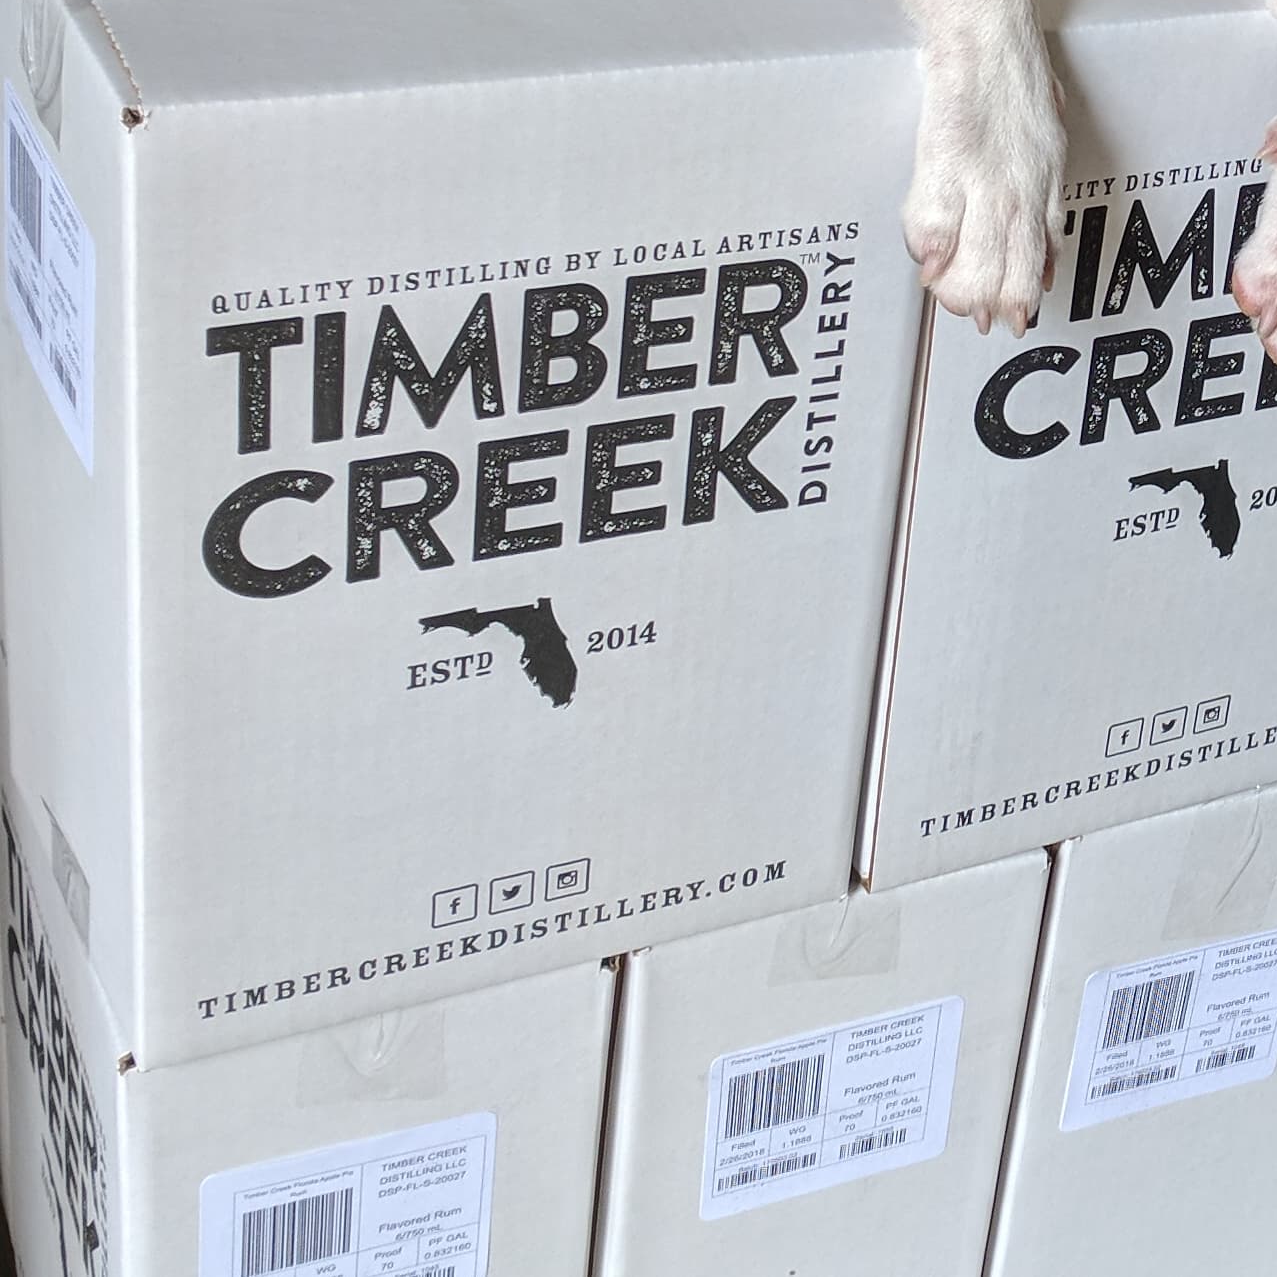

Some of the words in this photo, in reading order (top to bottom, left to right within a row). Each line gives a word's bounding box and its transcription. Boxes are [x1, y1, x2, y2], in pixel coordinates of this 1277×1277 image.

[1125, 158, 1263, 192] DISTILLING
[211, 279, 353, 315] QUALITY
[368, 256, 552, 295] DISTILLING
[566, 250, 602, 271] BY
[614, 239, 706, 266] LOCAL
[716, 222, 860, 253] ARTISANS
[206, 258, 808, 455] TIMBER
[798, 251, 857, 507] DISTILLERY
[202, 395, 797, 599] CREEK
[586, 621, 657, 655] 2014
[198, 859, 787, 1020] TIMBERCREEKDISTILLERY.COM
[2, 804, 99, 1219] TIMBER
[1206, 996, 1246, 1012] Flavored
[1248, 990, 1270, 1002] Rum
[848, 1031, 903, 1051] DISTILLING
[904, 1026, 922, 1037] LLC
[850, 1023, 887, 1039] TIMBER
[890, 1015, 924, 1029] CREEK
[844, 1077, 889, 1096] Flavored
[892, 1071, 916, 1084] Rum
[839, 1109, 863, 1122] Proof
[379, 1163, 442, 1185] DISTILLING
[444, 1157, 466, 1170] LLC
[381, 1154, 424, 1172] TIMBER
[427, 1145, 467, 1162] CREEK
[378, 1213, 429, 1233] Flavored
[434, 1206, 462, 1219] Rum
[446, 1231, 468, 1243] GAL
[374, 1246, 401, 1260] Proof
[381, 1261, 393, 1270] 70
[317, 1263, 336, 1275] WG
